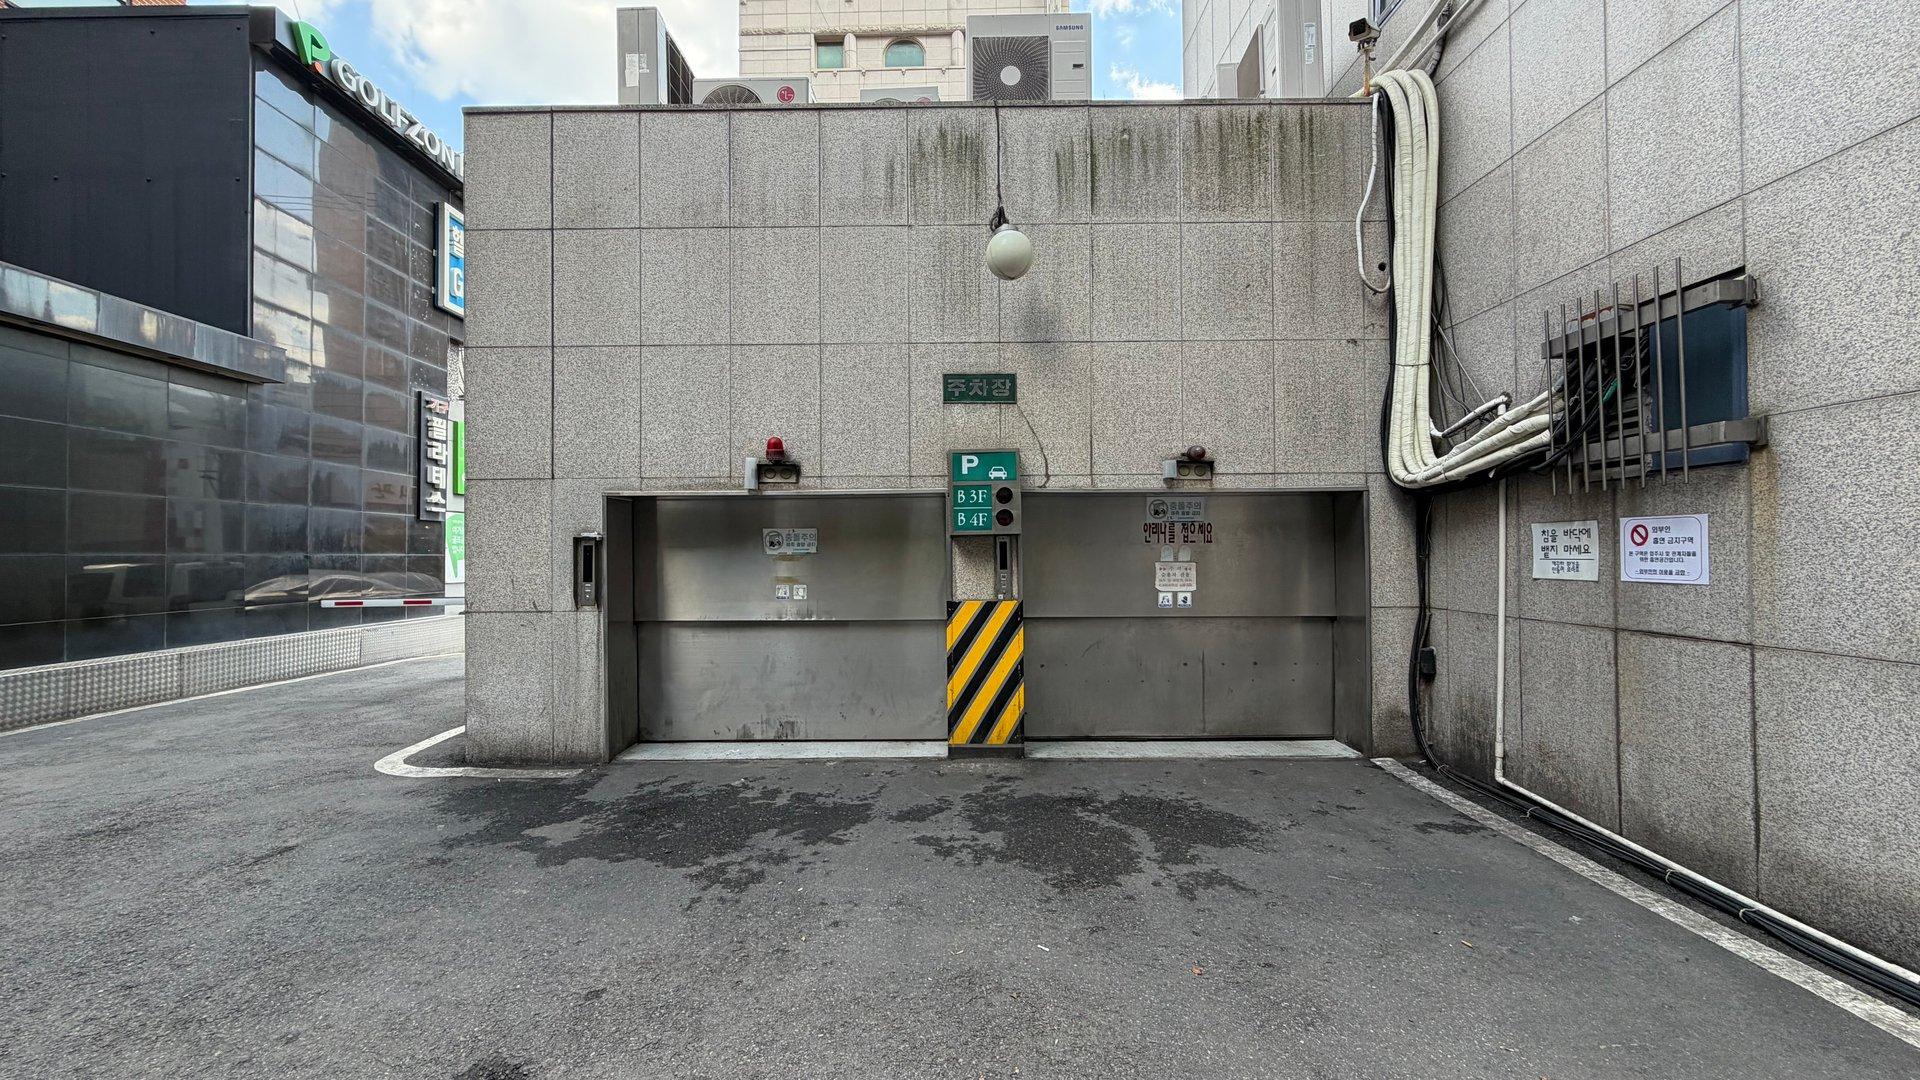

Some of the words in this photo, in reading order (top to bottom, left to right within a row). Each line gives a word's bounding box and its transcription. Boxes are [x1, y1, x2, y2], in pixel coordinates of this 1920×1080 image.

[331, 59, 455, 170] GOLFZON
[948, 379, 1012, 397] 주차장
[425, 416, 447, 513] 필라테스
[961, 455, 979, 475] P
[1181, 522, 1213, 543] 접으세요
[1541, 529, 1558, 543] 침을
[1563, 528, 1591, 542] 바닥에
[1541, 545, 1558, 558] 뱉지
[1563, 544, 1591, 555] 마세요
